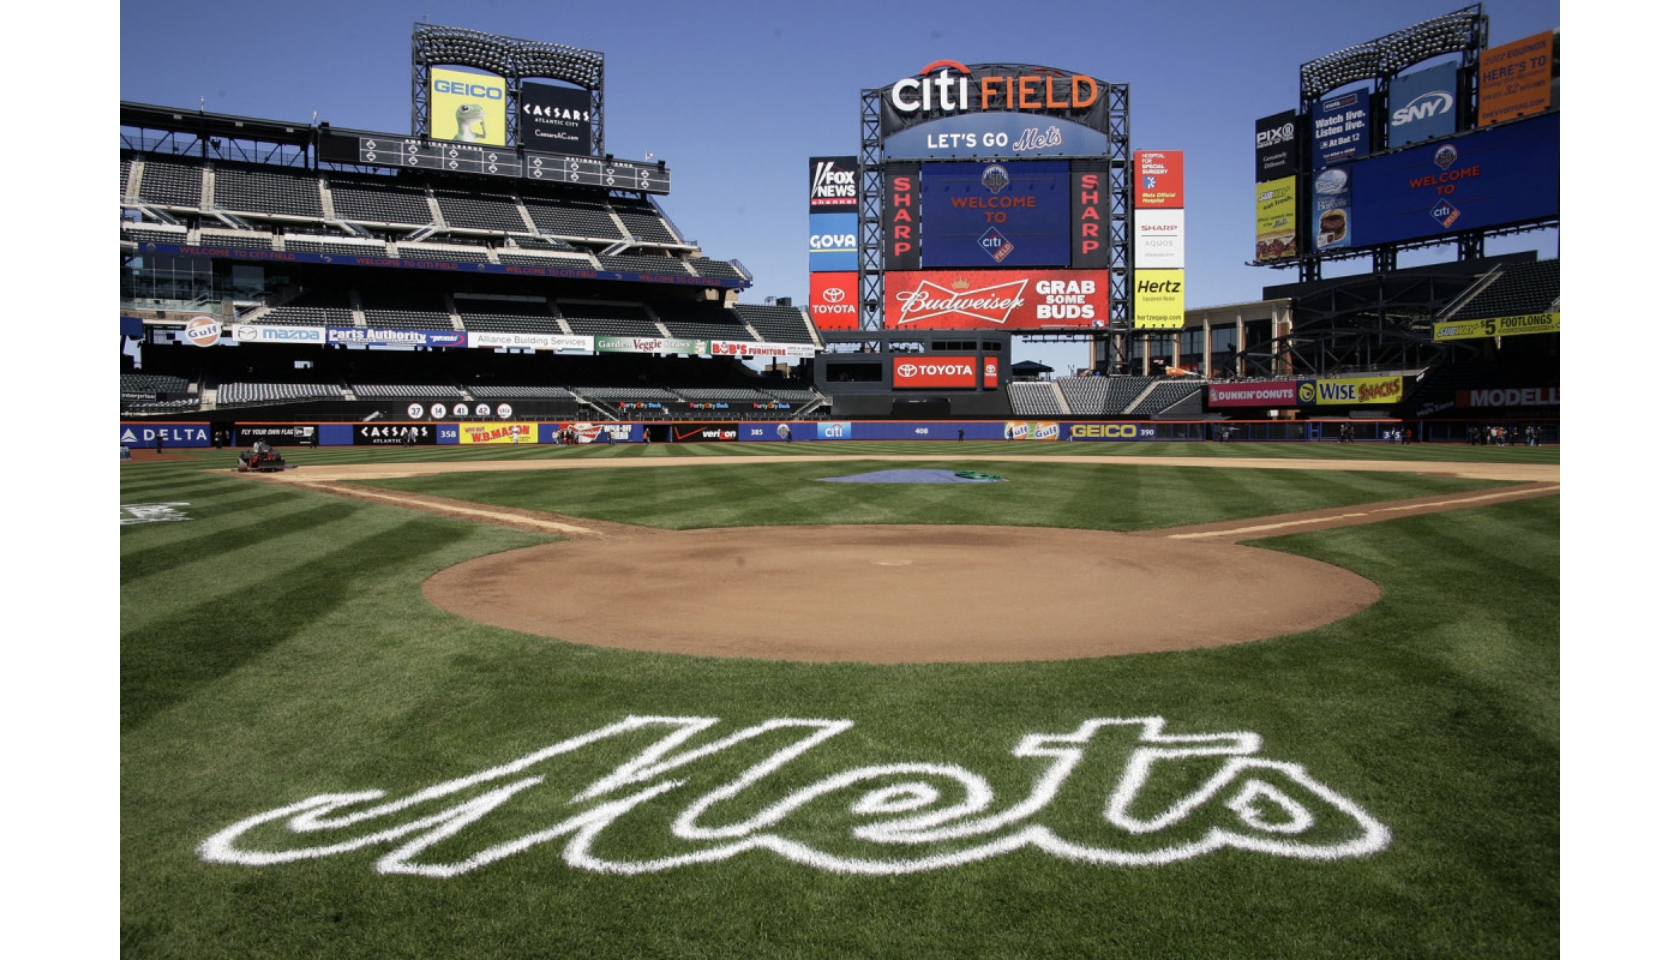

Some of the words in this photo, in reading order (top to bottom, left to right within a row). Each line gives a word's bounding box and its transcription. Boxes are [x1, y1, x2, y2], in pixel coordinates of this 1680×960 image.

[1482, 60, 1527, 83] HERE'S
[1530, 54, 1547, 69] TO
[434, 79, 503, 100] GEICO
[892, 67, 968, 112] citi
[981, 74, 1098, 110] FIELD
[523, 103, 590, 122] CAESARS
[1391, 97, 1446, 127] SNY
[534, 117, 564, 126] ATLANTIC
[564, 120, 579, 128] CITY
[1315, 114, 1344, 129] Watch
[1345, 109, 1366, 121] live.
[534, 129, 579, 141] CaesarsAC.com
[1315, 125, 1344, 139] Listen
[1345, 120, 1365, 132] live.
[927, 133, 977, 149] LET'S
[982, 132, 1009, 148] GO
[1012, 125, 1063, 151] Mets
[826, 171, 856, 184] FOX
[1409, 165, 1481, 189] WELCOME
[816, 185, 856, 197] NEWS
[1436, 184, 1456, 196] TO
[951, 196, 1037, 209] WELCOME
[893, 177, 912, 257] SHARP
[984, 211, 1008, 224] TO
[1081, 174, 1100, 254] SHARP
[1433, 206, 1450, 217] citi
[1141, 224, 1178, 232] SHARP
[810, 234, 857, 249] GOYA
[982, 236, 1002, 247] citi
[1144, 239, 1174, 247] AQUOS
[179, 246, 229, 257] WELCOME
[233, 250, 247, 258] TO
[249, 251, 269, 259] CITI
[269, 252, 296, 260] FIELD
[995, 242, 1012, 261] FIELD
[356, 257, 400, 267] WELCOME
[417, 261, 434, 269] CITI
[435, 262, 458, 270] FIELD
[505, 266, 545, 275] WELCOME
[576, 270, 598, 278] FIELD
[638, 274, 674, 283] WELCOME
[1036, 280, 1096, 295] GRAB
[1137, 280, 1182, 293] Hertz
[896, 290, 1024, 312] Budweiser
[1046, 295, 1086, 304] SOME
[813, 304, 856, 314] TOYOTA
[1036, 304, 1095, 319] BUDS
[188, 324, 218, 338] Gulf
[1437, 322, 1479, 337] SUBWAY
[1500, 314, 1553, 327] FOOTLONGS
[262, 328, 320, 340] mazda
[328, 329, 365, 342] Parts
[366, 329, 427, 343] Authority
[478, 335, 512, 344] Alliance
[514, 336, 548, 346] Building
[551, 337, 587, 346] Services
[598, 340, 632, 348] Garden
[633, 338, 662, 352] Veggie
[748, 347, 786, 356] FURNITURE
[918, 365, 973, 376] TOYOTA
[1218, 390, 1256, 400] DUNKIN'
[1256, 388, 1294, 399] DONUTS
[1319, 384, 1356, 400] WISE
[1358, 378, 1401, 402] SNACKS
[410, 407, 421, 415] 37
[435, 407, 443, 415] 14
[456, 407, 465, 415] 41
[478, 407, 488, 415] 42
[143, 429, 208, 441] DELTA
[241, 428, 252, 436] FLY
[252, 428, 267, 436] YOUR
[267, 428, 280, 436] OWN
[281, 428, 294, 436] FLAG
[440, 430, 457, 438] 358
[703, 429, 737, 439] verizon
[825, 426, 843, 438] citi
[1035, 425, 1058, 438] Gulf
[1072, 424, 1137, 438] GEICO
[197, 715, 1391, 877] Mets
